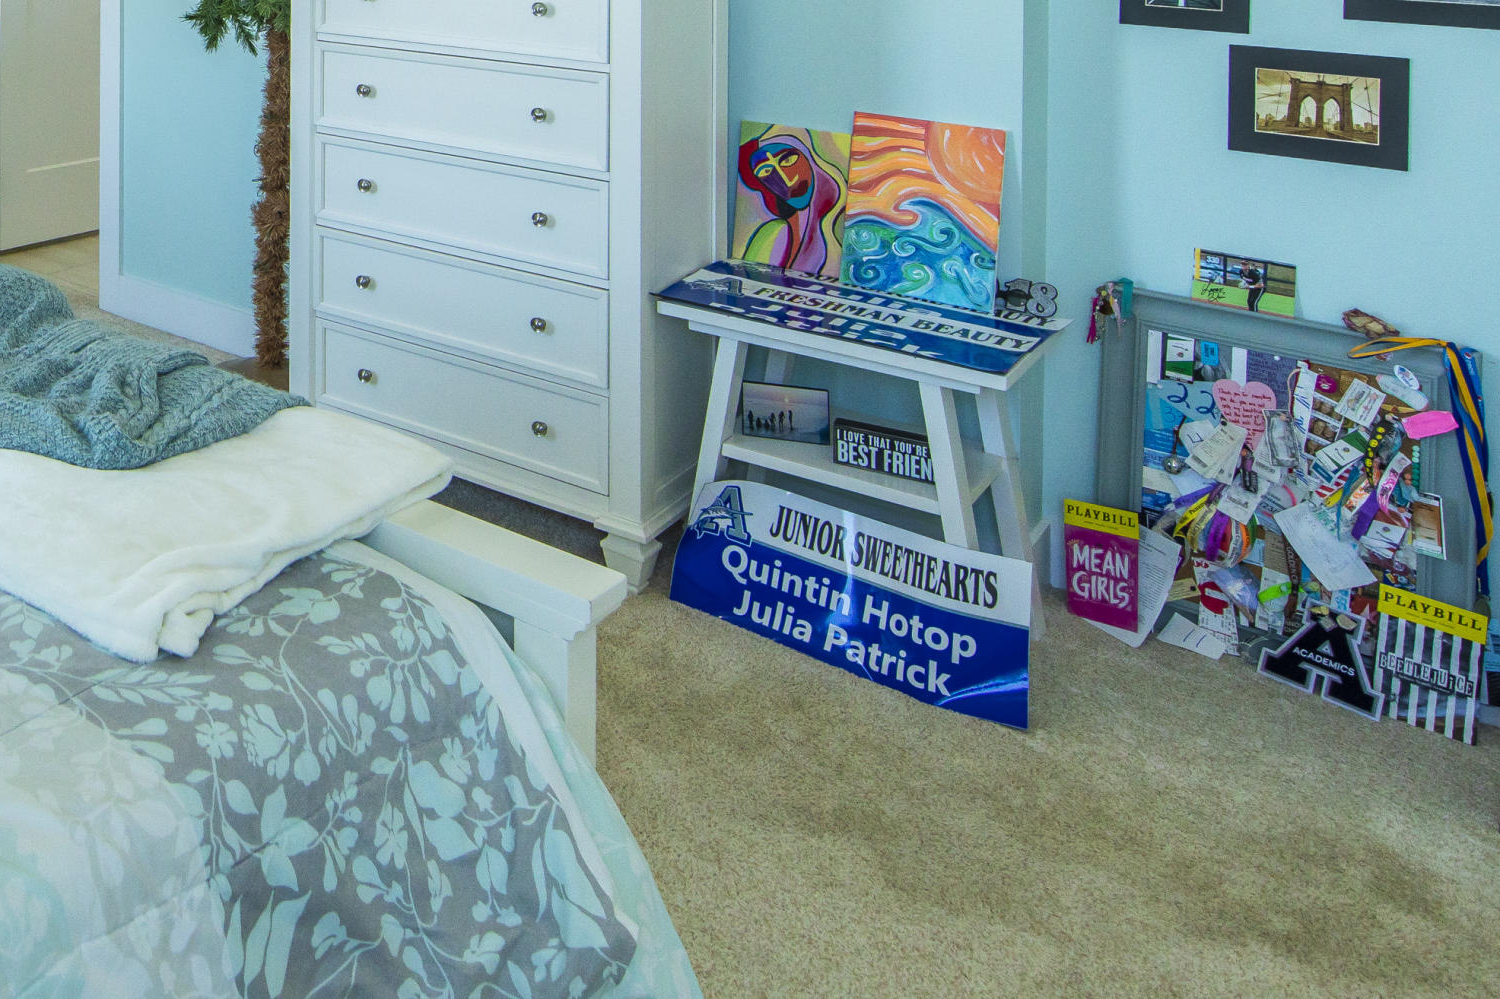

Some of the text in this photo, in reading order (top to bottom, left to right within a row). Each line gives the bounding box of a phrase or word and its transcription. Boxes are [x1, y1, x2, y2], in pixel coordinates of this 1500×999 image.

[753, 287, 1034, 350] FRESHMAN BEAUTY
[837, 429, 928, 458] I LOVE THAT YOU'RE
[837, 439, 933, 482] BEST FRIEN
[1066, 503, 1136, 528] PLAYBILL
[769, 504, 999, 610] JUNIOR SWEETHEARTS
[1072, 542, 1130, 580] MEAN
[721, 544, 978, 666] Quintin Hotop
[1072, 569, 1131, 609] GIRLS
[1383, 591, 1483, 632] PLAYBILL
[732, 590, 952, 698] Julia Patrick
[1292, 646, 1356, 676] ACADEMICS
